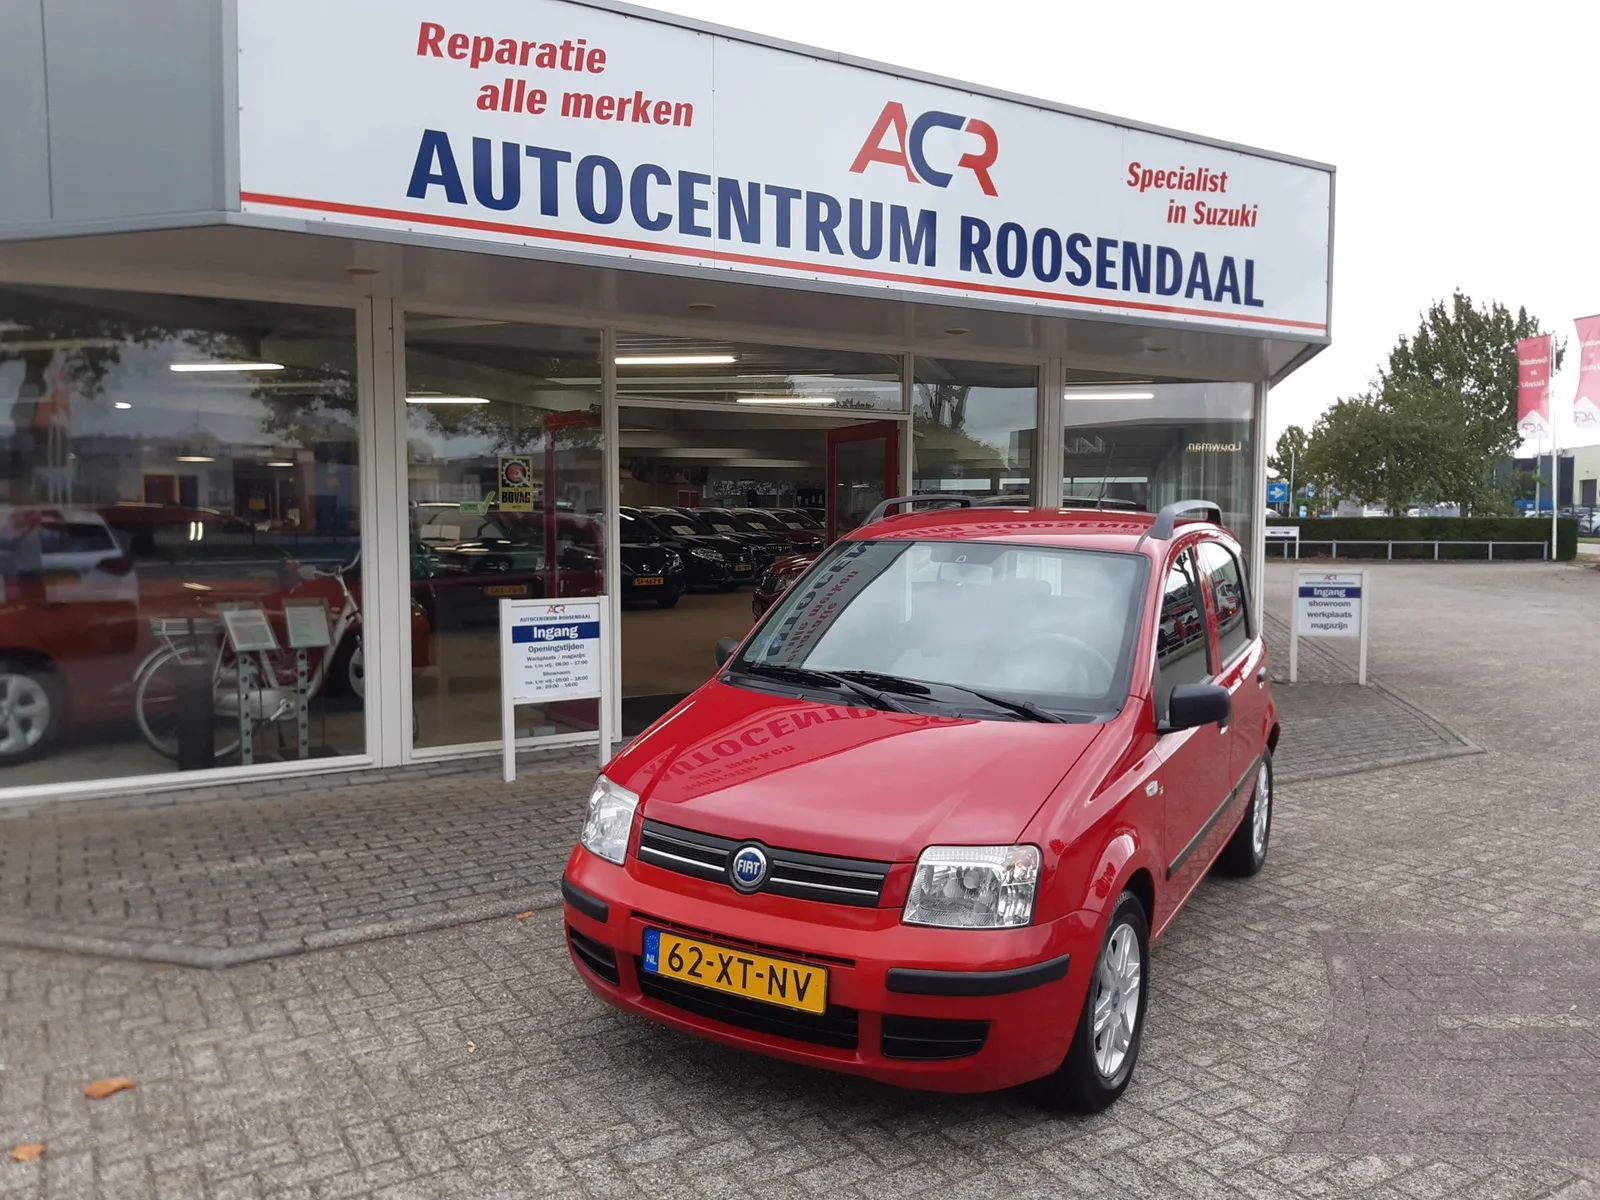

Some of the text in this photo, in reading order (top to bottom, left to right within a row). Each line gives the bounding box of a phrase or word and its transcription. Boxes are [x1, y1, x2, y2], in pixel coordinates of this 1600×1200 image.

[417, 21, 607, 74] Reparatie
[475, 78, 694, 127] alle merken
[848, 99, 999, 198] ACR
[1126, 161, 1228, 194] Specialist
[406, 128, 1264, 308] AUTOCENTRUM ROOSENDAAL
[1166, 198, 1259, 228] in Suzuki
[502, 491, 531, 504] BOVAG
[1313, 587, 1346, 598] Ingang
[546, 604, 567, 614] ACR
[1308, 600, 1352, 608] showroom
[558, 613, 591, 621] ROOSENDAAL
[1306, 611, 1353, 619] werkplaats
[533, 625, 579, 640] Ingang
[1310, 621, 1349, 631] magazijn
[528, 643, 585, 654] Openingstijden
[526, 654, 557, 662] Werkplaats
[736, 858, 761, 876] FIAT
[646, 941, 812, 1003] NL 62-XT-NV
